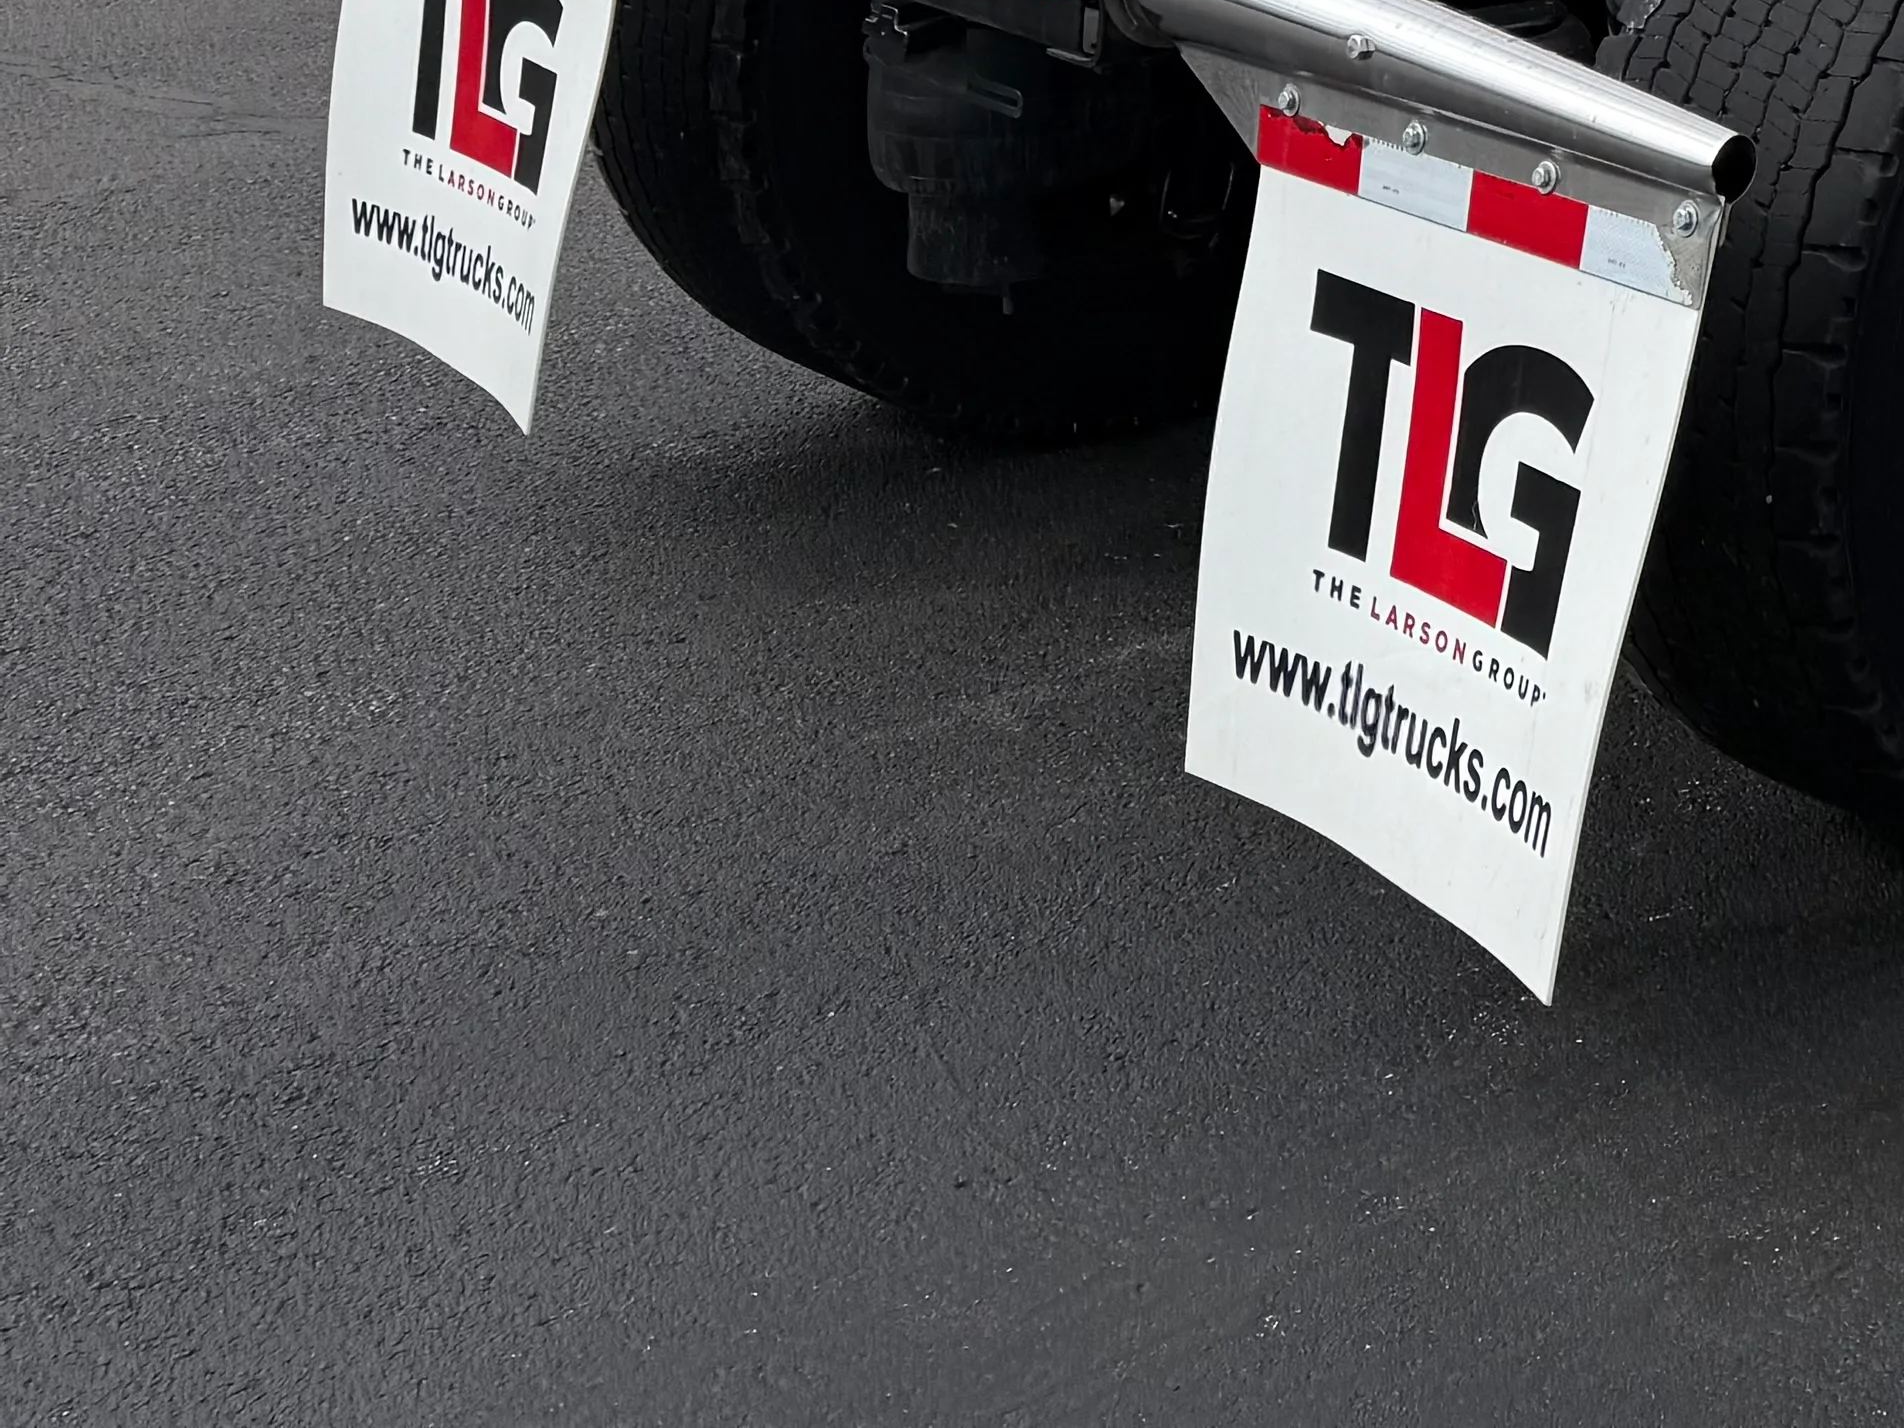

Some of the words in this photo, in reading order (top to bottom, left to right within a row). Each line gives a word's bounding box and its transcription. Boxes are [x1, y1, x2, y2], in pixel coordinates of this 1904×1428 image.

[402, 148, 433, 175] THE
[438, 163, 495, 207] LARSON
[497, 194, 535, 231] GROUP
[351, 198, 536, 336] www.tlgtrucks.com
[1310, 268, 1595, 661] TLG
[1312, 569, 1362, 609] THE
[1370, 596, 1467, 664] LARSON
[1471, 649, 1542, 707] GROUP
[1233, 629, 1552, 858] www.tlgtrucks.com
